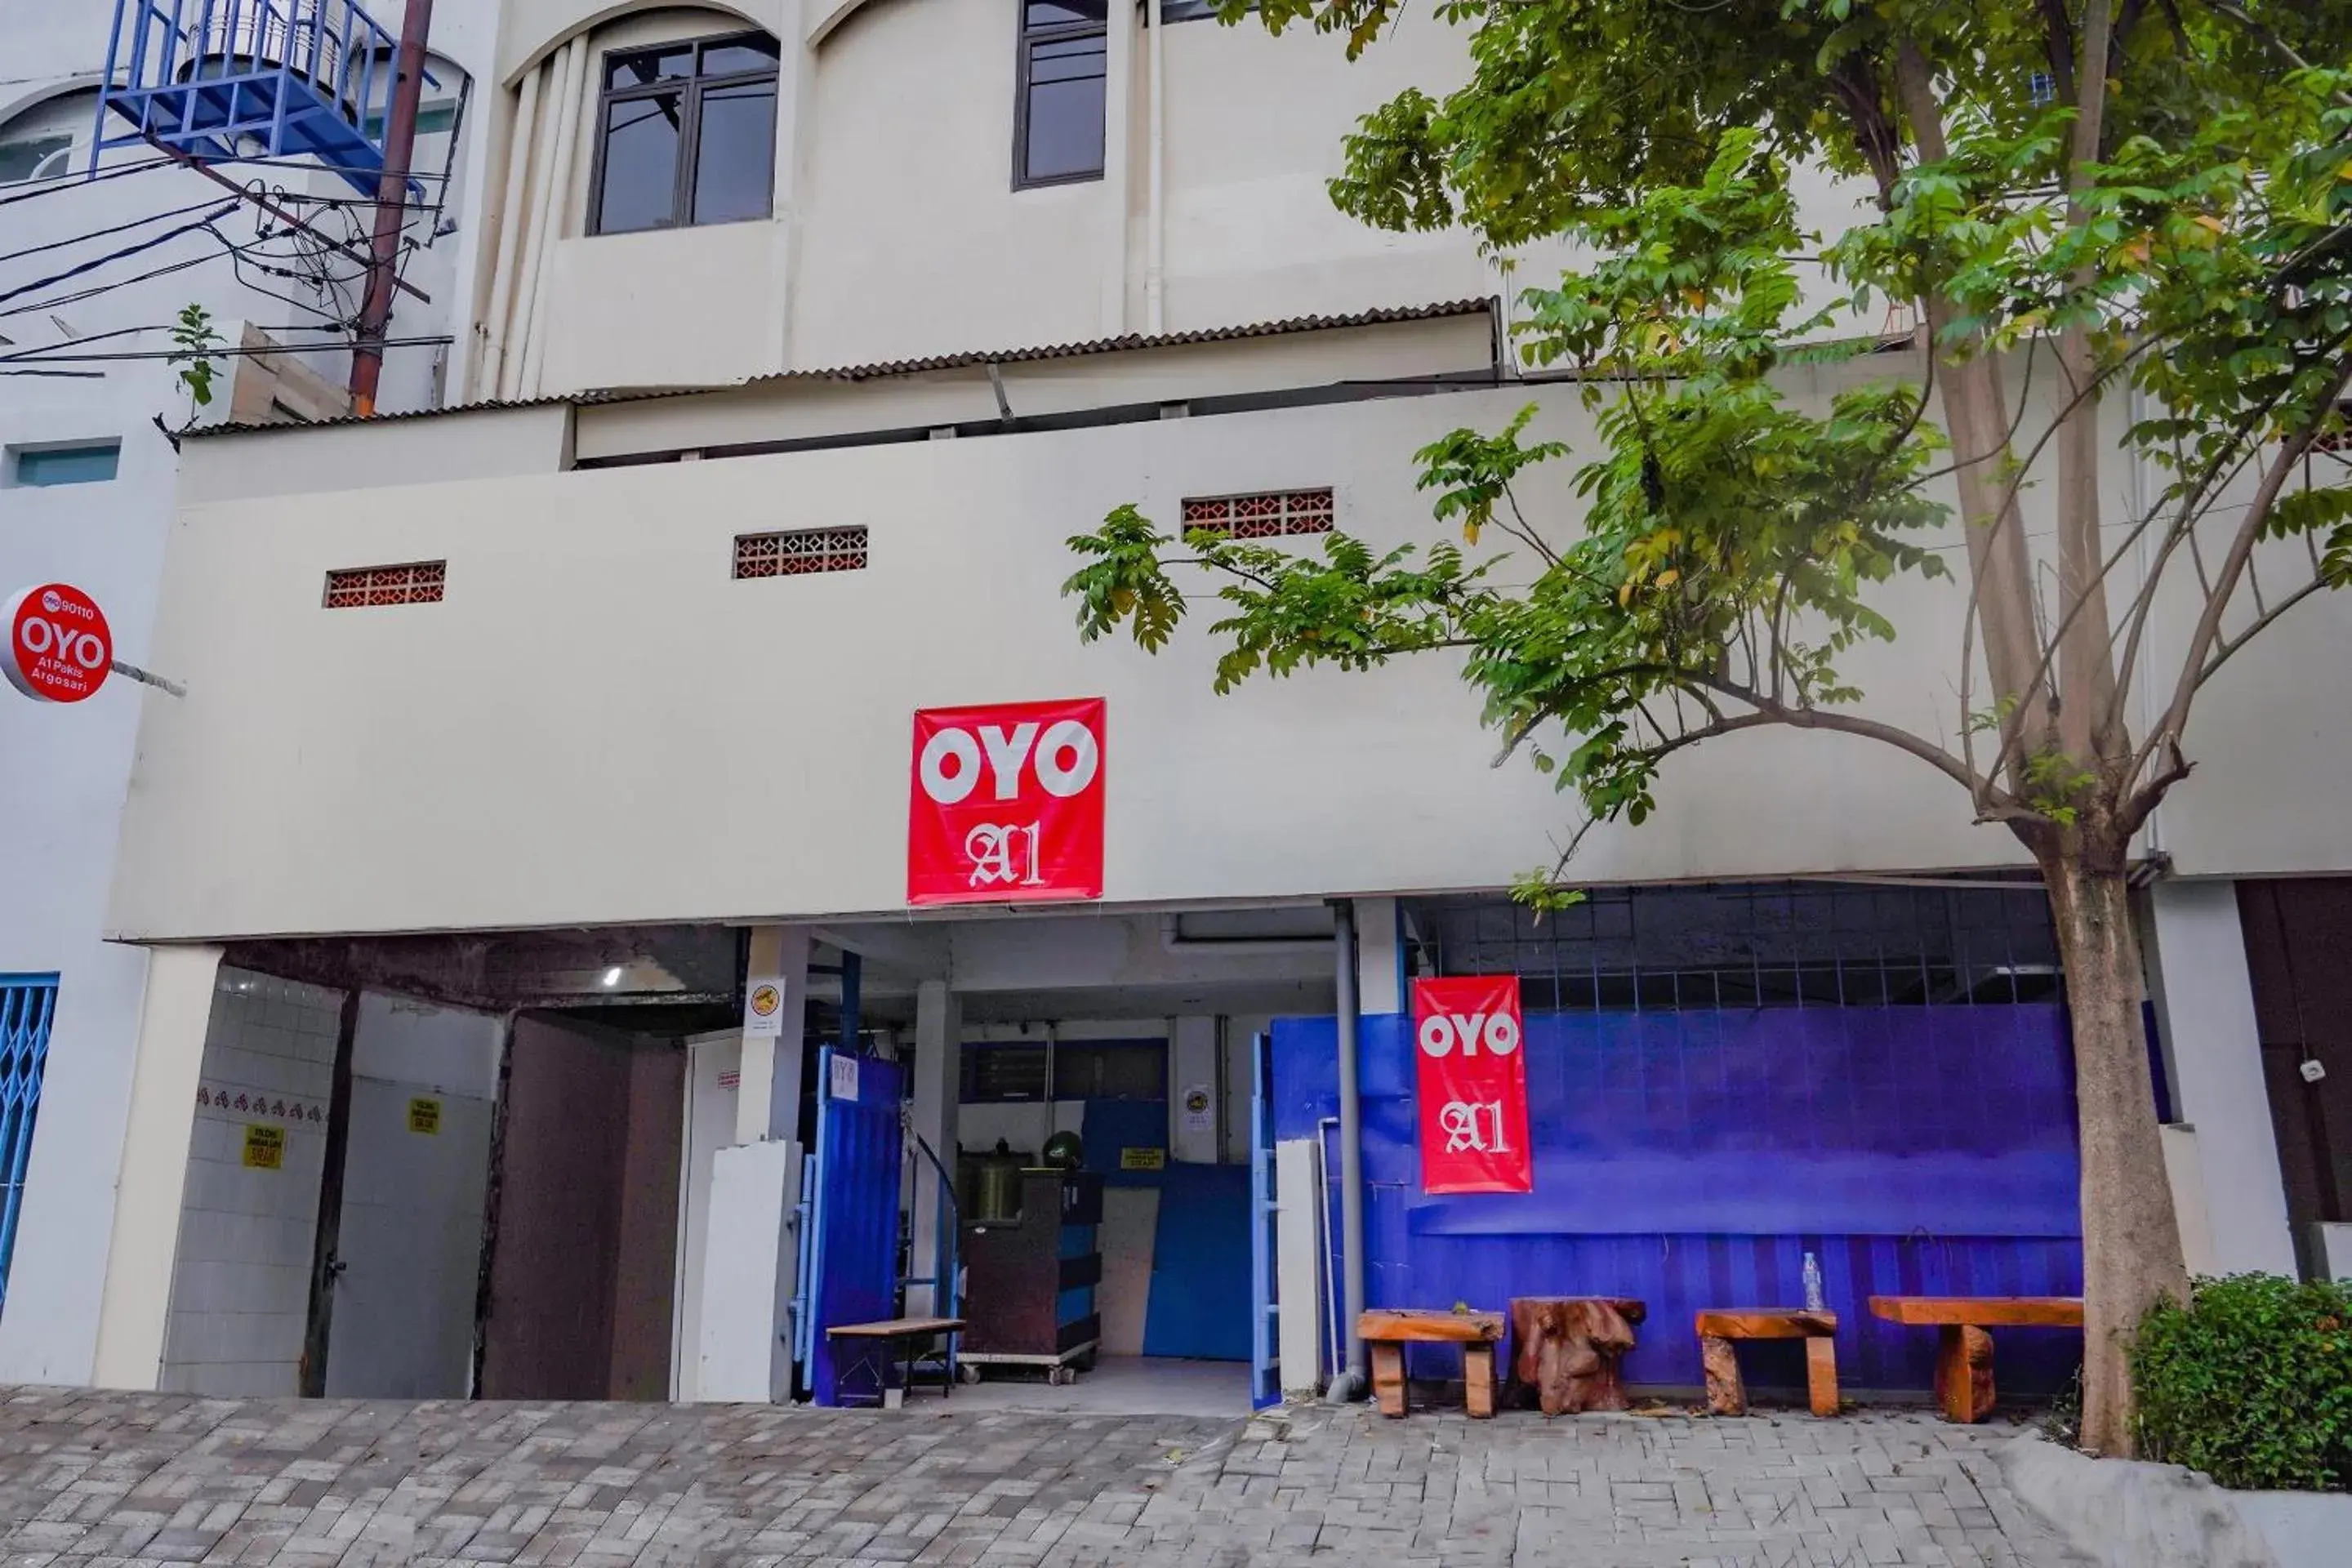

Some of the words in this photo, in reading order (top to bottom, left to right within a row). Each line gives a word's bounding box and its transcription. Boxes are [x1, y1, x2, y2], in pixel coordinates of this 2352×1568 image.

[21, 617, 104, 668] OYO
[31, 667, 87, 692] Argosari
[920, 719, 1098, 804] OYO
[965, 820, 1045, 887] A1
[1419, 1012, 1519, 1058] OYO
[1440, 1099, 1510, 1153] A1
